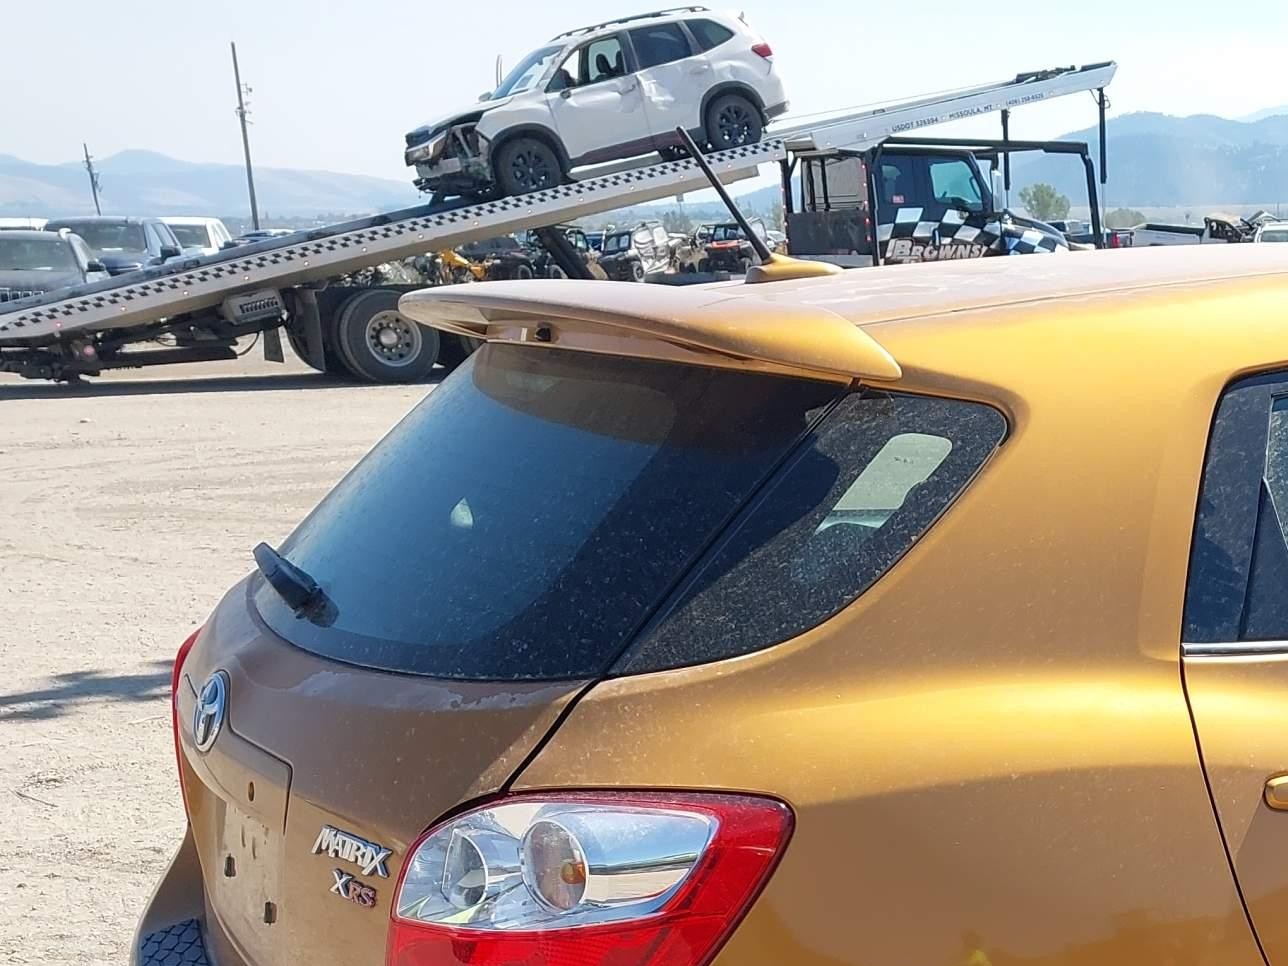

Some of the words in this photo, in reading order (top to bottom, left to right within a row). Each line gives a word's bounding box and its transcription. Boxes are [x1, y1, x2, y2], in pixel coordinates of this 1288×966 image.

[892, 121, 914, 132] USDOT
[311, 825, 393, 878] MATRIX
[329, 868, 377, 908] XRS
